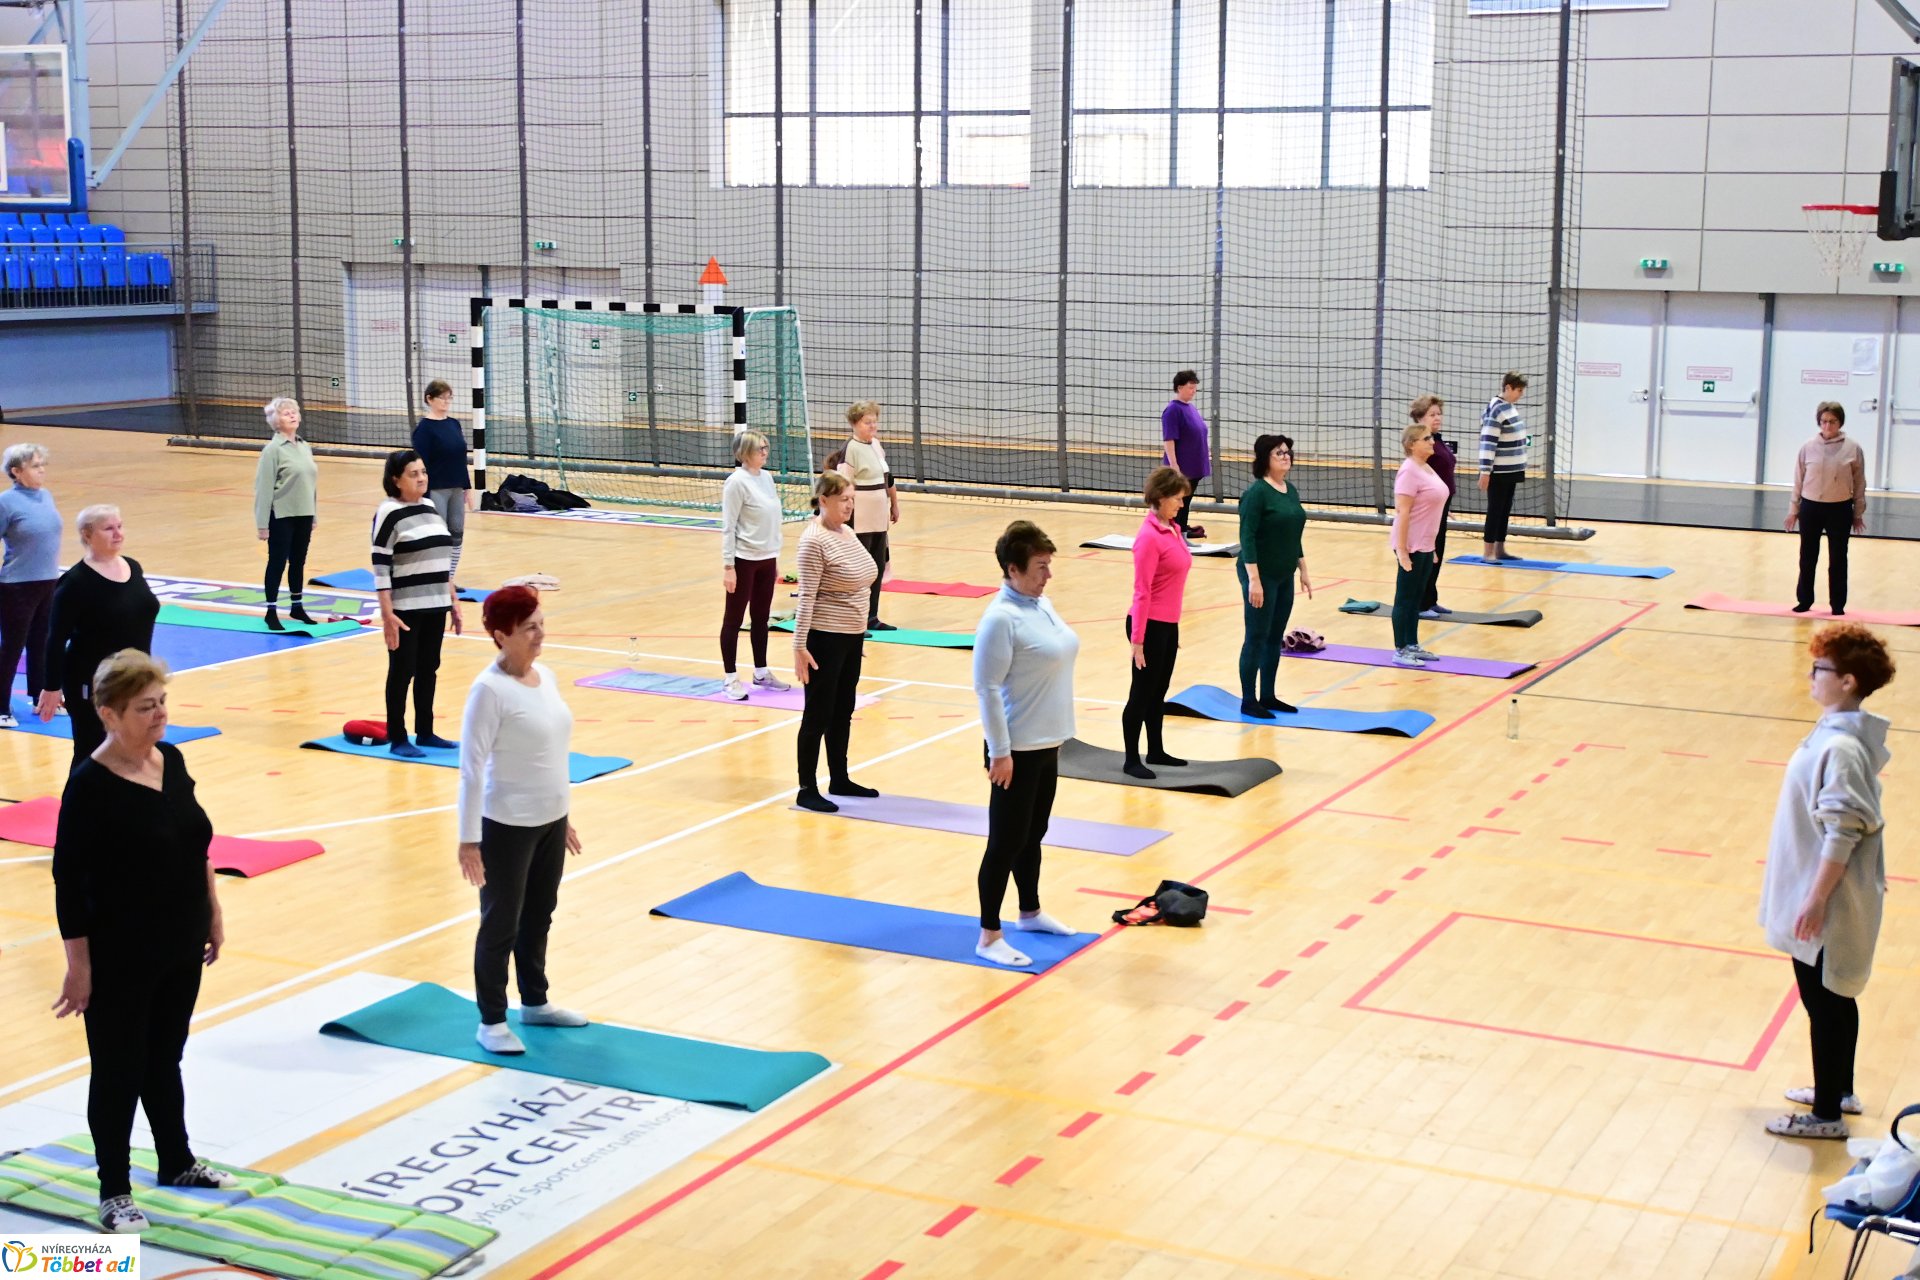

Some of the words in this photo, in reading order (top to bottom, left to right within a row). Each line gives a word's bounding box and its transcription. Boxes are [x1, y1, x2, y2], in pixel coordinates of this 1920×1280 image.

[341, 1079, 600, 1198] ÍREGYHÁZI
[412, 1096, 656, 1214] ORTCENTR
[471, 1194, 528, 1224] yházi
